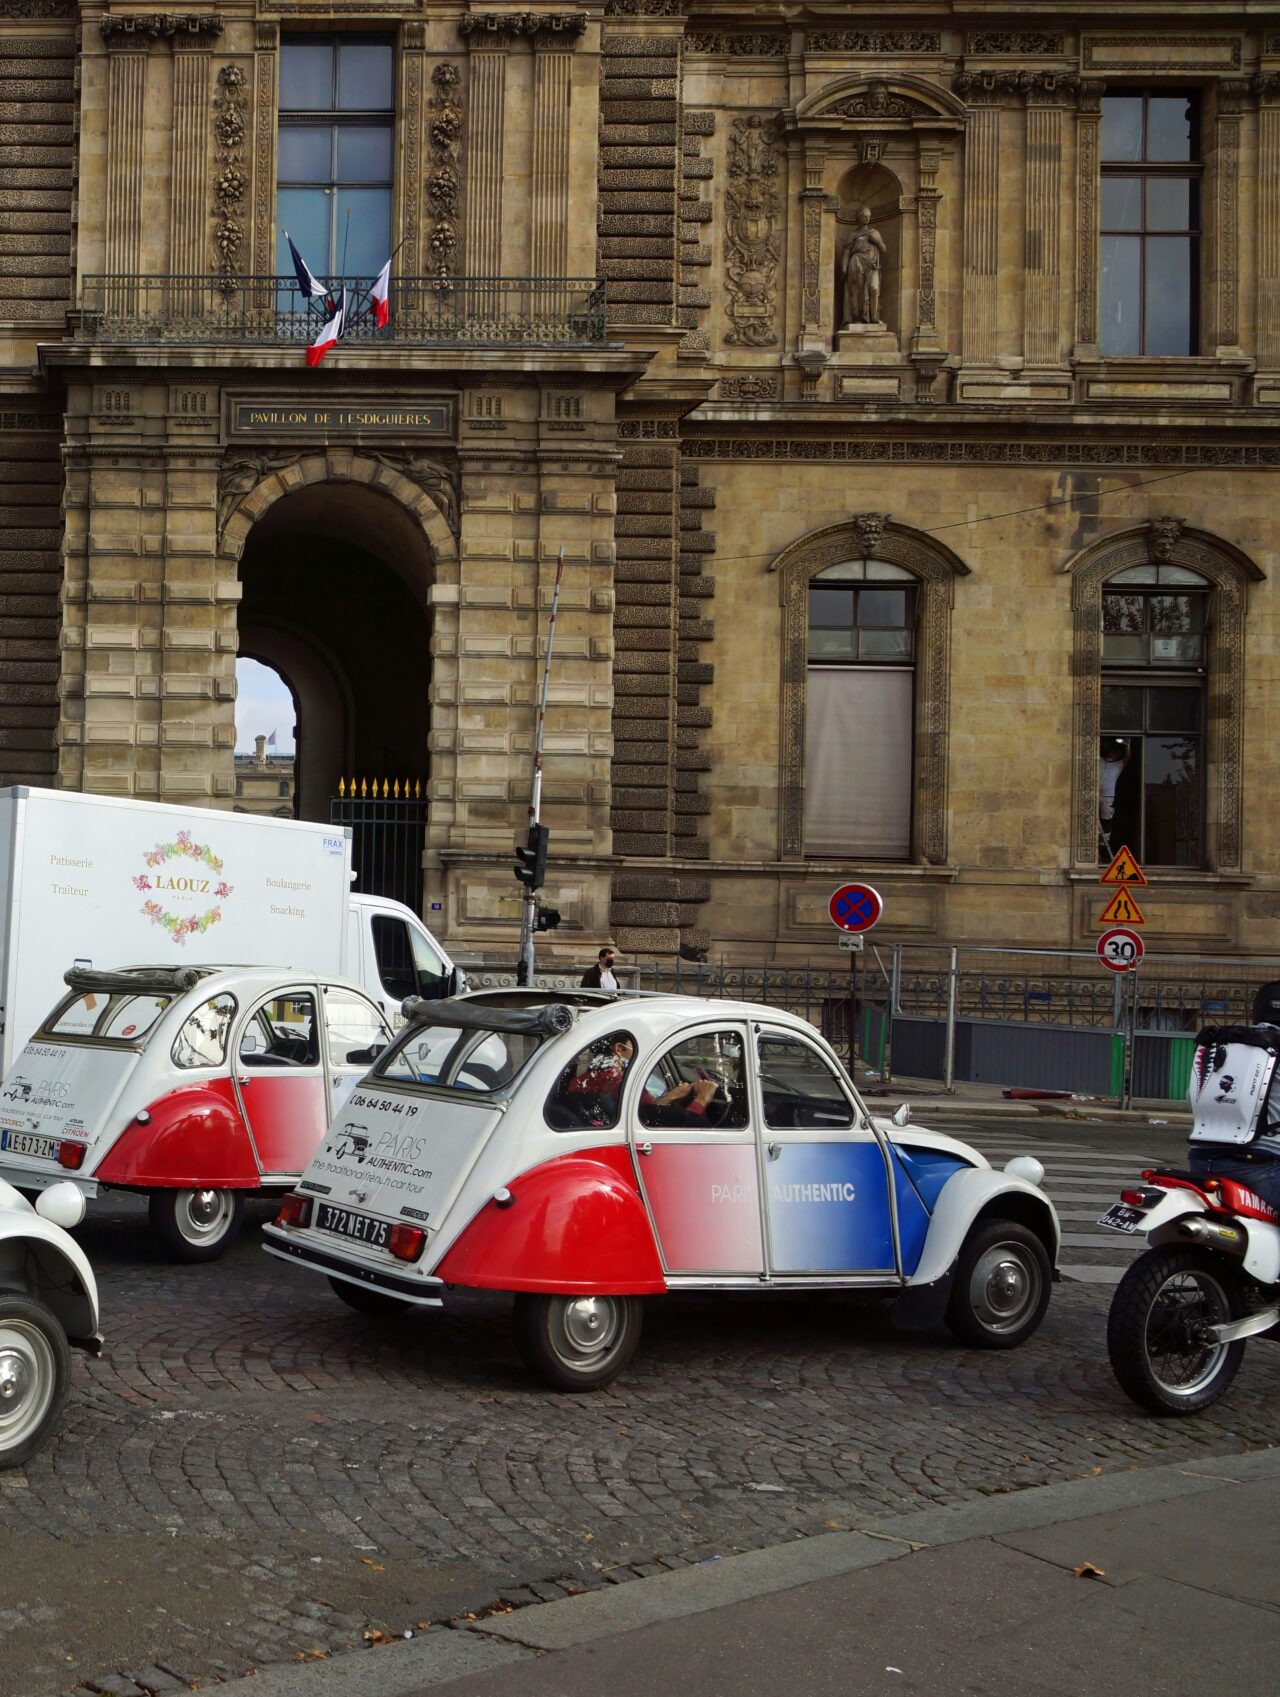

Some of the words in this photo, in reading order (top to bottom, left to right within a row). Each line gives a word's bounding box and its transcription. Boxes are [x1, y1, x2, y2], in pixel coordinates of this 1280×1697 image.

[250, 412, 307, 423] PAVILLON
[314, 412, 332, 423] DE
[51, 883, 89, 896] Traiteur
[155, 875, 210, 893] LAOUZ
[266, 877, 312, 892] Boulangerie
[270, 904, 305, 918] Snacking
[1107, 941, 1136, 960] 30
[36, 1080, 71, 1098] PARIS
[354, 1095, 367, 1106] 06
[366, 1098, 379, 1109] 64
[378, 1101, 392, 1112] 50
[391, 1104, 405, 1114] 44
[405, 1106, 419, 1117] 19
[374, 1132, 427, 1159] PARIS
[311, 1159, 326, 1170] the
[327, 1162, 365, 1180] traditional
[391, 1179, 408, 1190] car
[407, 1182, 425, 1194] tour
[366, 1156, 433, 1180] AUTHENTIC.com
[772, 1183, 856, 1202] AUTHENTIC
[324, 1207, 347, 1232] 372
[346, 1213, 372, 1239] NET
[371, 1221, 388, 1244] 75
